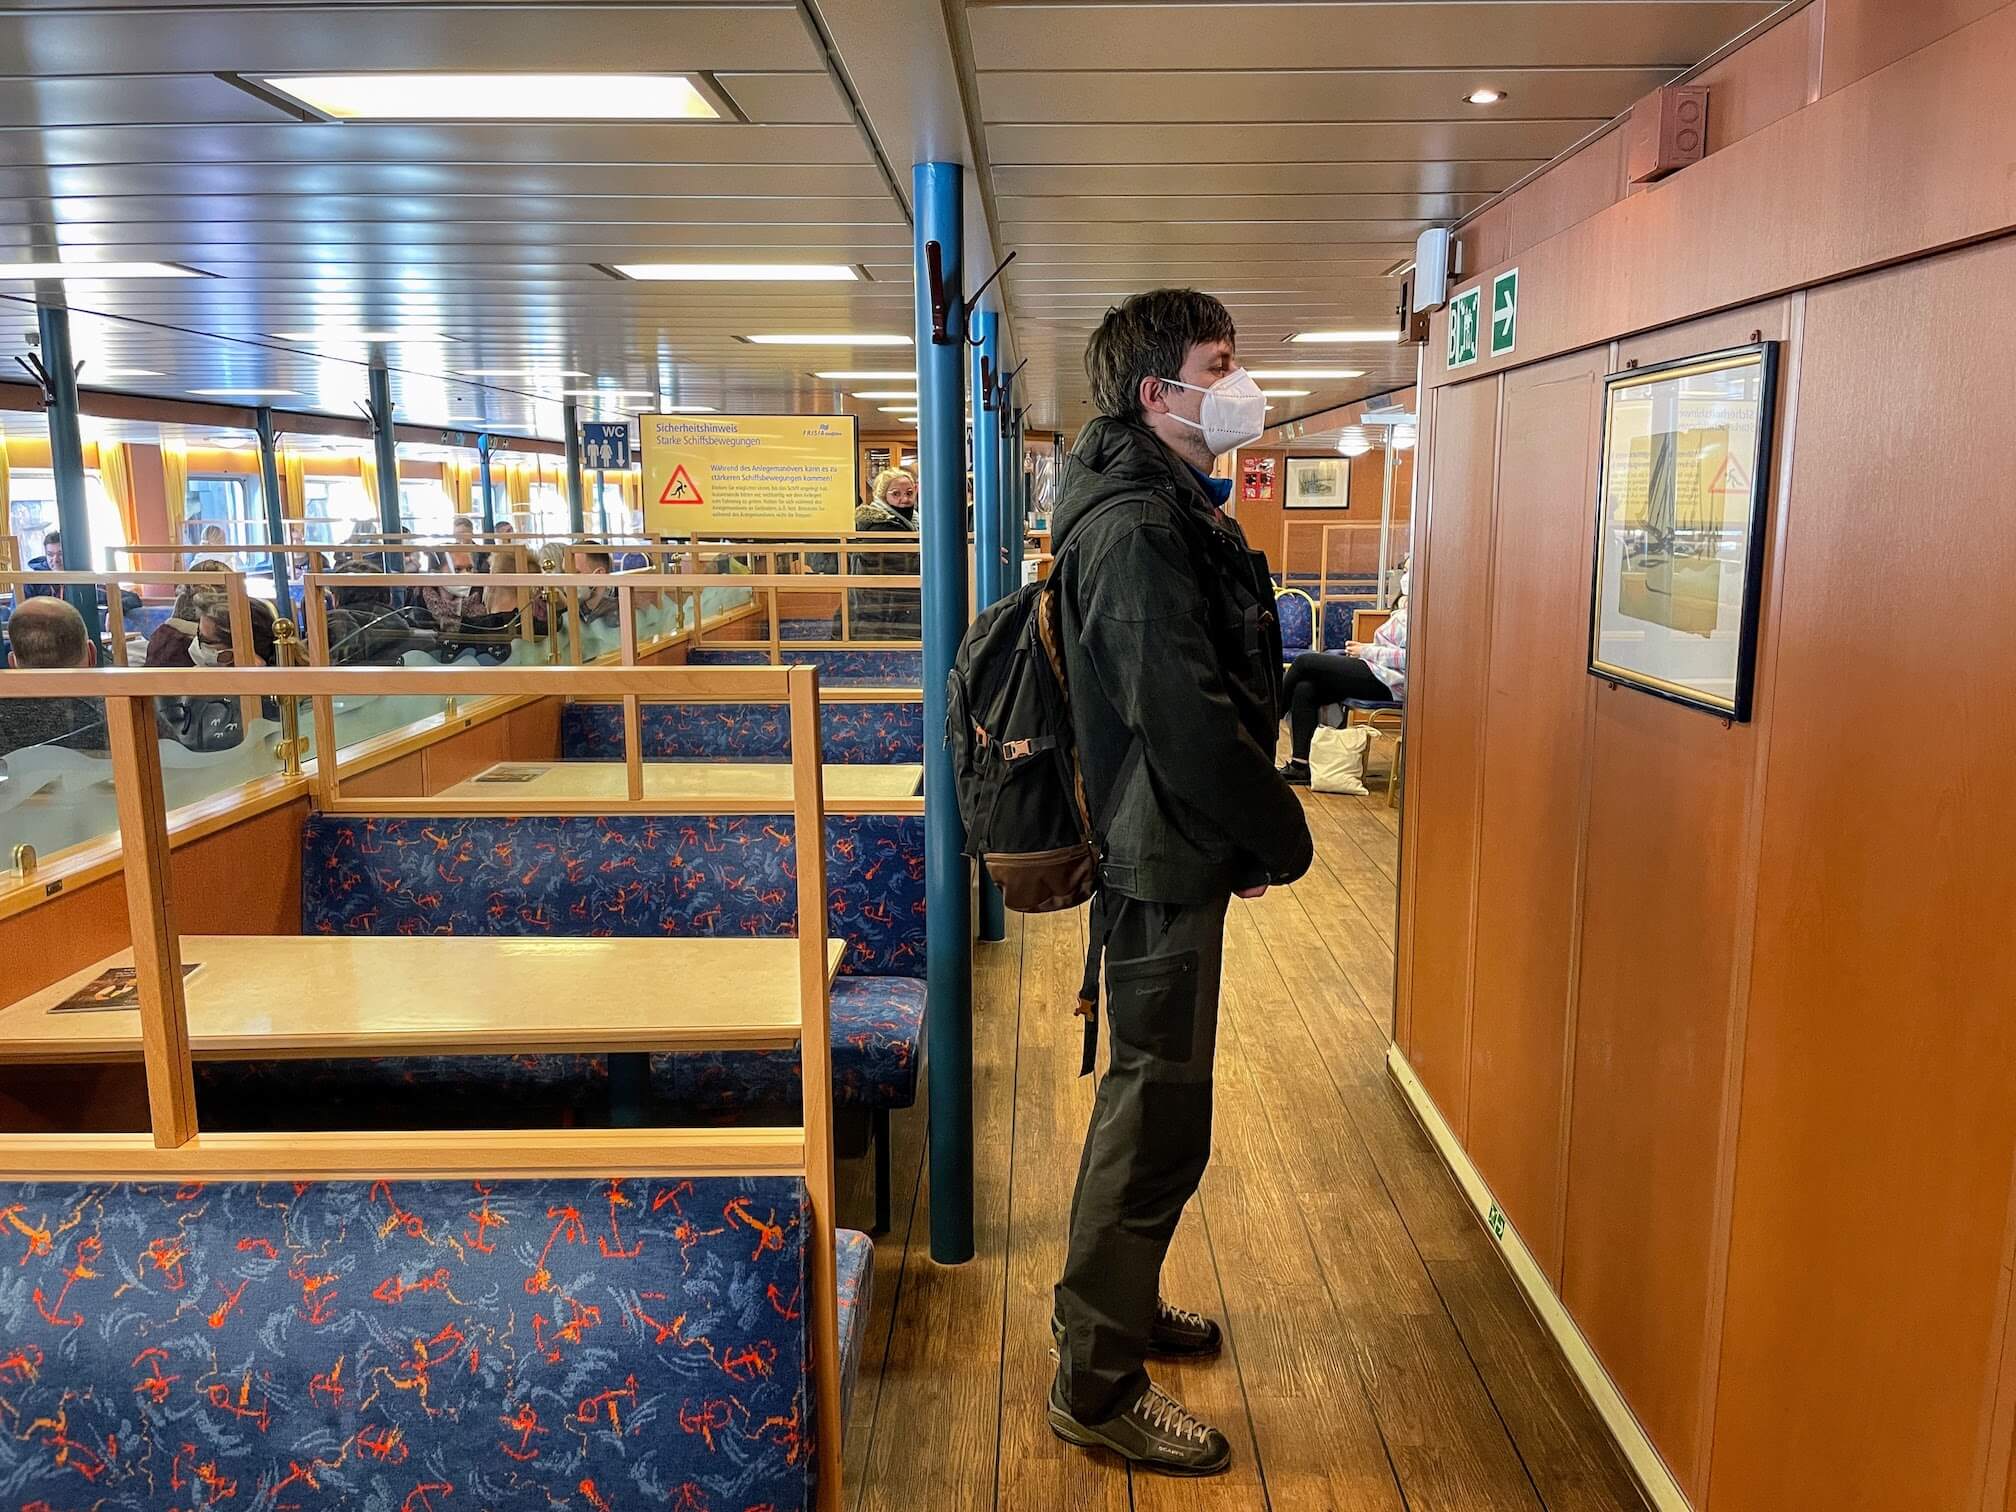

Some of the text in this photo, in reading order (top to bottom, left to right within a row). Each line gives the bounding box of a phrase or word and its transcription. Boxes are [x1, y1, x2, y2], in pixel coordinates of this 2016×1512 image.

[602, 426, 625, 438] WC
[656, 423, 738, 433] Sicherheitshinweis
[656, 435, 761, 448] Starke Schiffsbewegungen
[711, 464, 738, 472] Während
